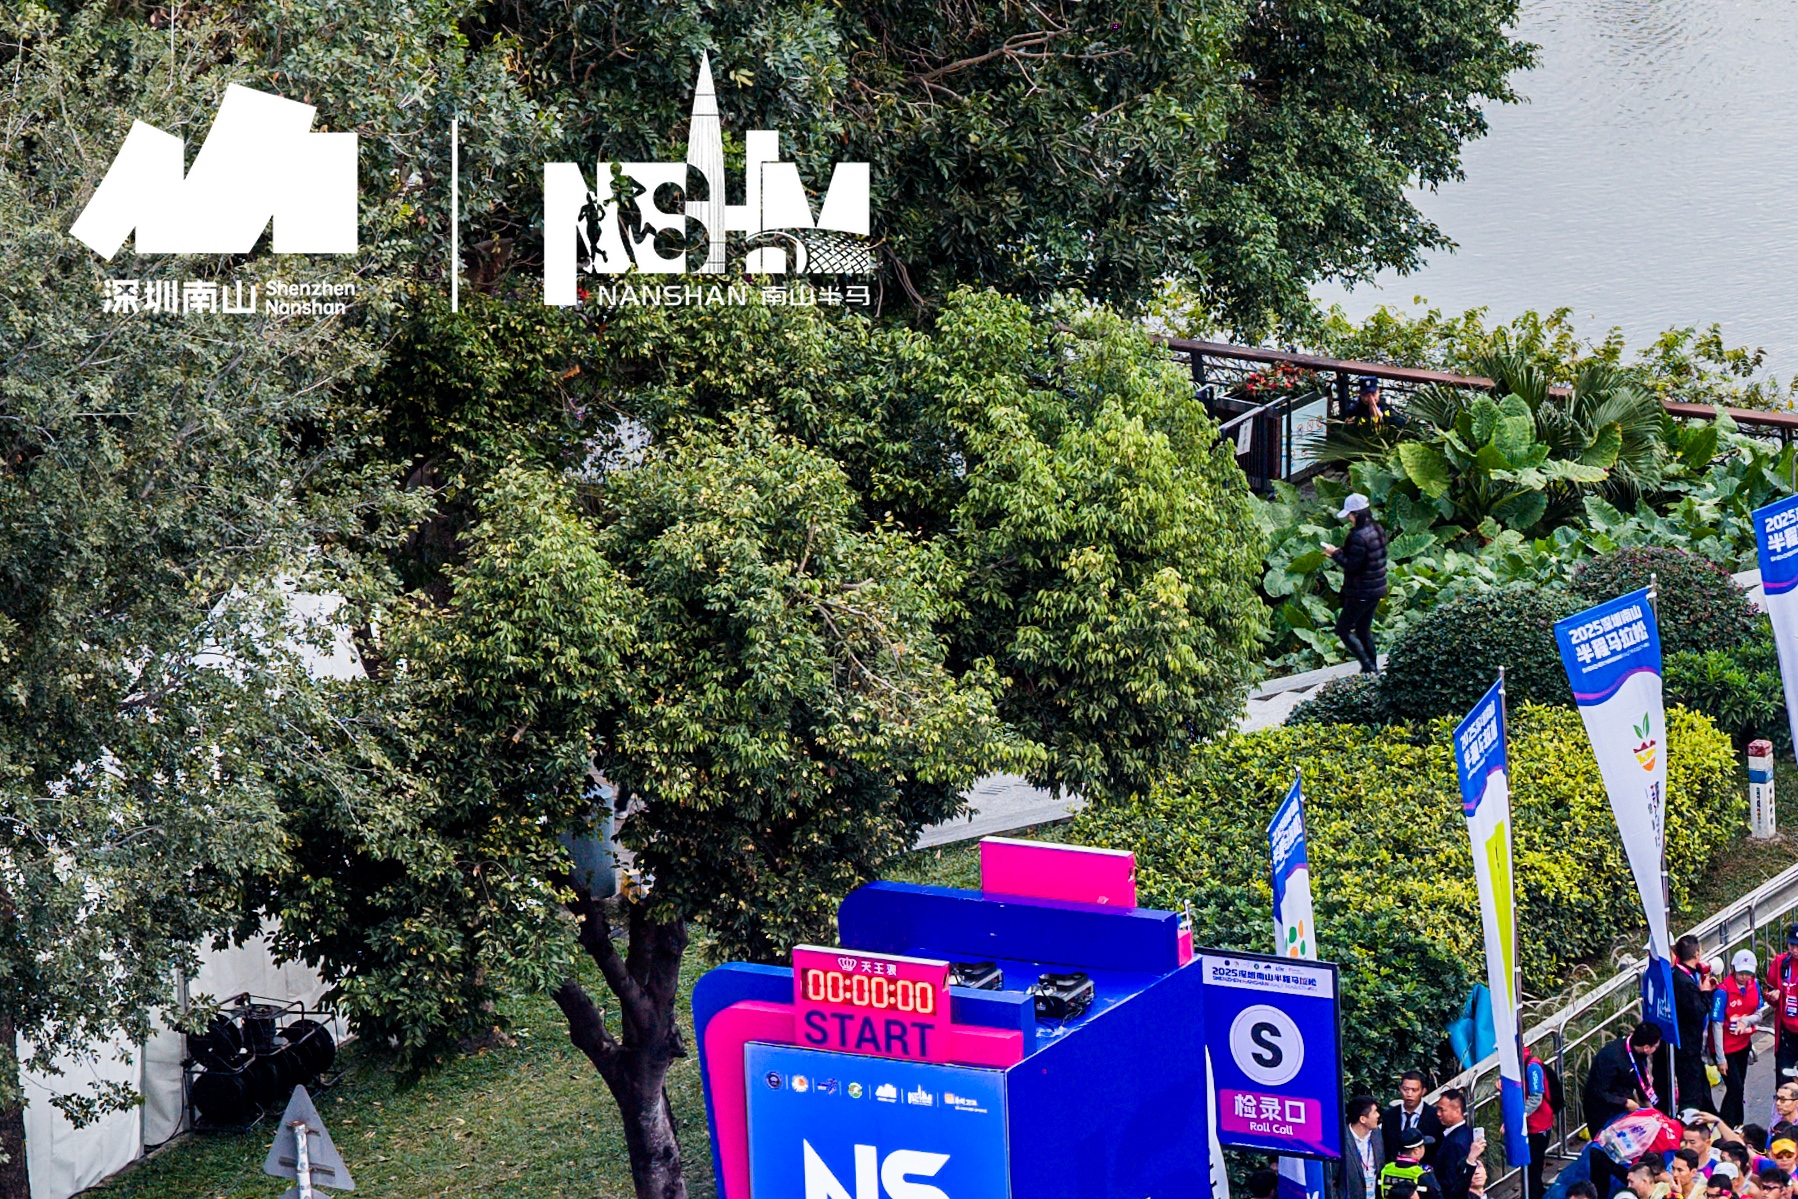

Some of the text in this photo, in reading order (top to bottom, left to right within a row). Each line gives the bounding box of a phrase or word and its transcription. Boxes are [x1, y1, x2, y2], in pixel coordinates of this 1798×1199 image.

[861, 961, 897, 976] 天王表
[808, 969, 933, 1014] 00:00:00
[805, 1010, 934, 1057] START
[1251, 1022, 1283, 1068] S
[1234, 1094, 1306, 1124] 检录口
[1250, 1121, 1294, 1136] Roll Call
